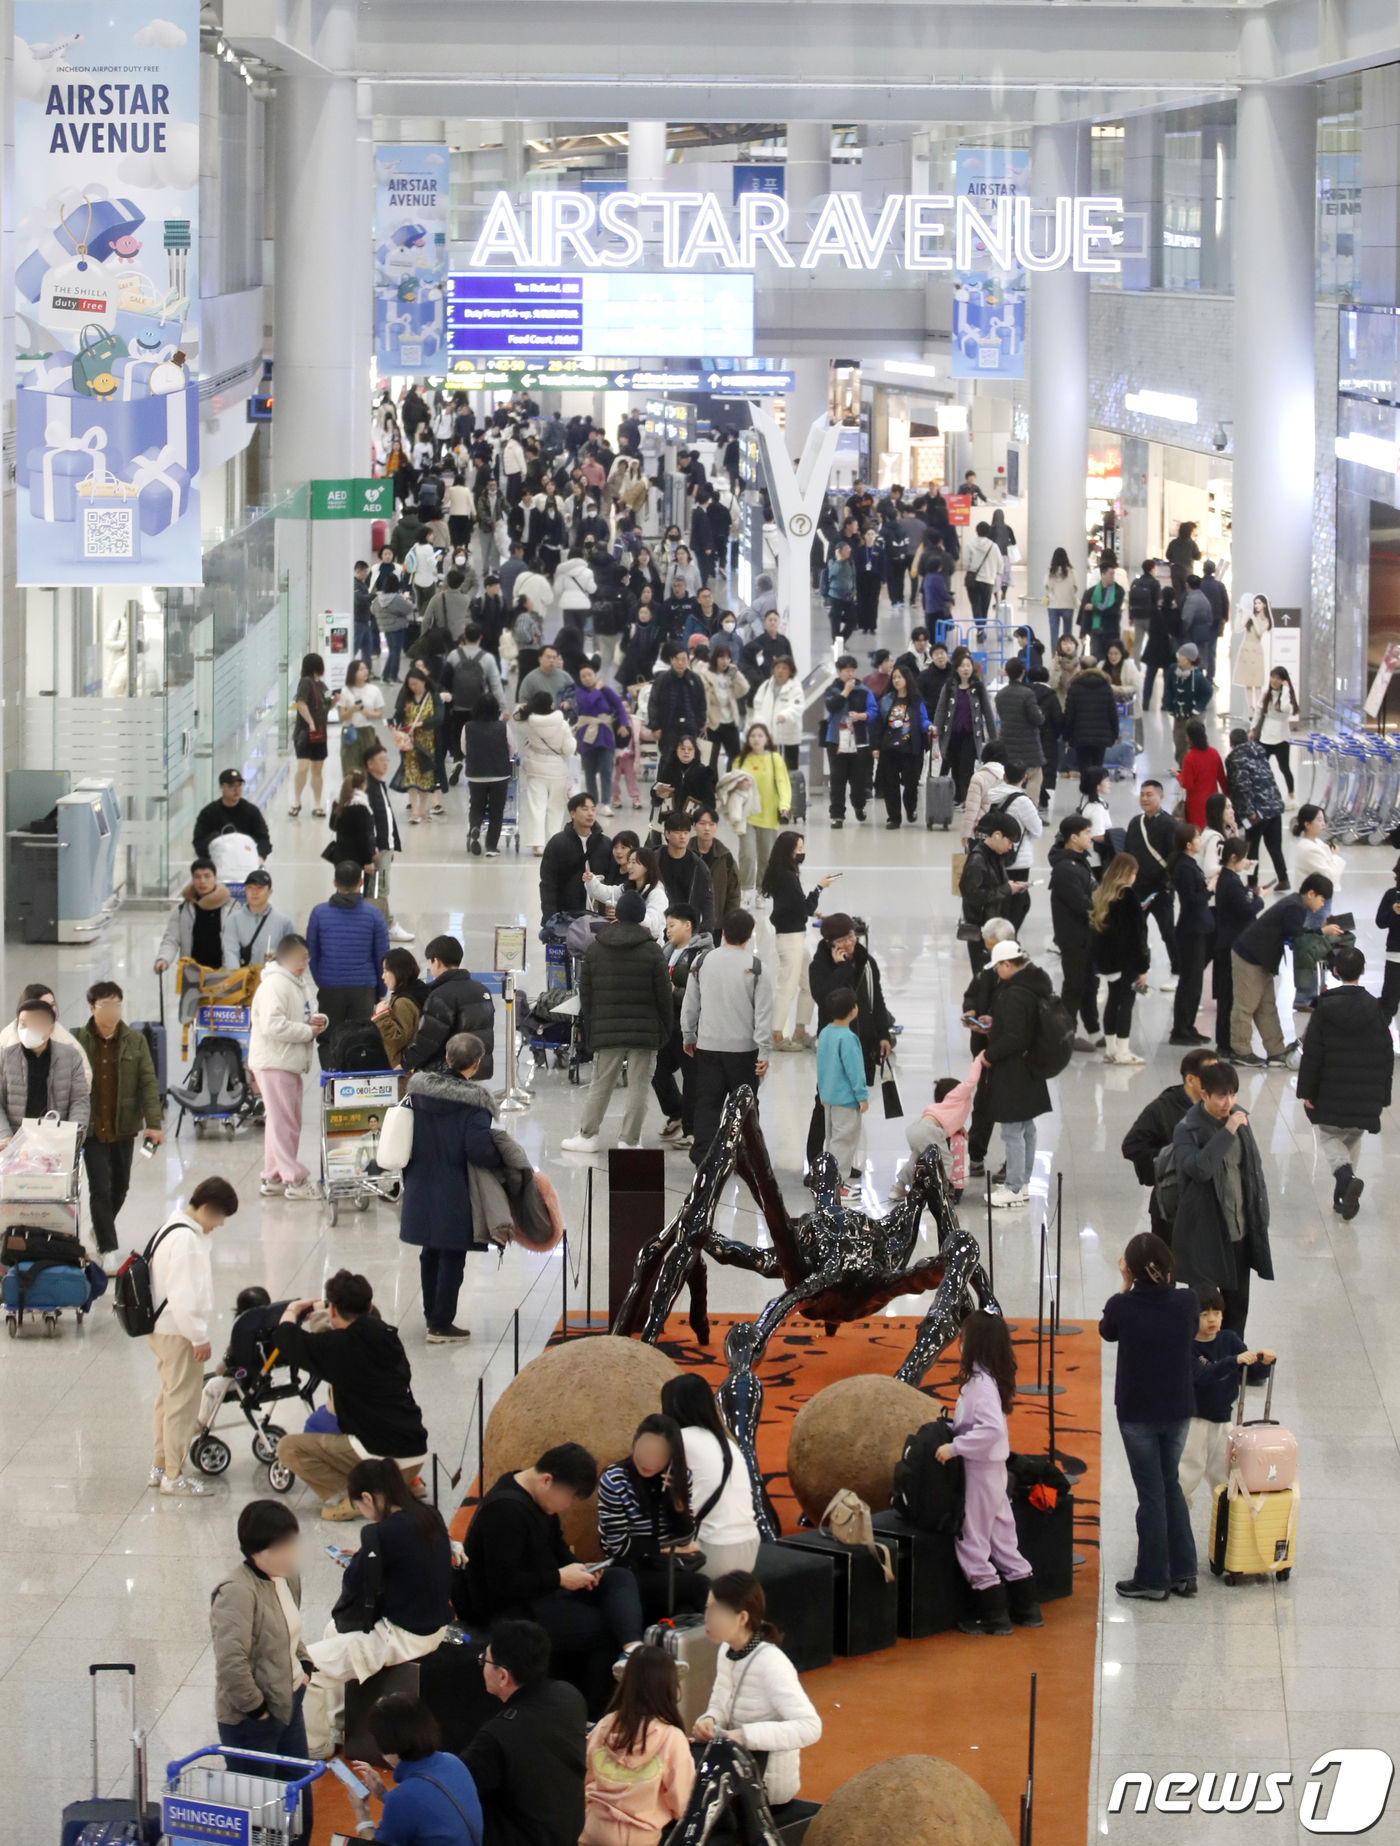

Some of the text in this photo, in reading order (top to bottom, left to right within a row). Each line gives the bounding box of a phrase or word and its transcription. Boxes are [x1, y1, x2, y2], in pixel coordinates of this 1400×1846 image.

[45, 84, 170, 116] AIRSTAR
[49, 122, 167, 154] AVENUE
[387, 178, 438, 192] AIRSTAR
[967, 182, 1017, 196] AIRSTAR
[389, 193, 437, 207] AVENUE
[469, 190, 1123, 273] AIRSTAR AVENUE
[54, 285, 108, 297] THE SHILLA
[55, 298, 103, 310] duty free
[129, 296, 146, 304] SALE
[327, 490, 347, 500] AED
[362, 504, 382, 512] AED
[356, 1086, 392, 1095] 에이스침대
[169, 1806, 242, 1831] SHINSEGAE
